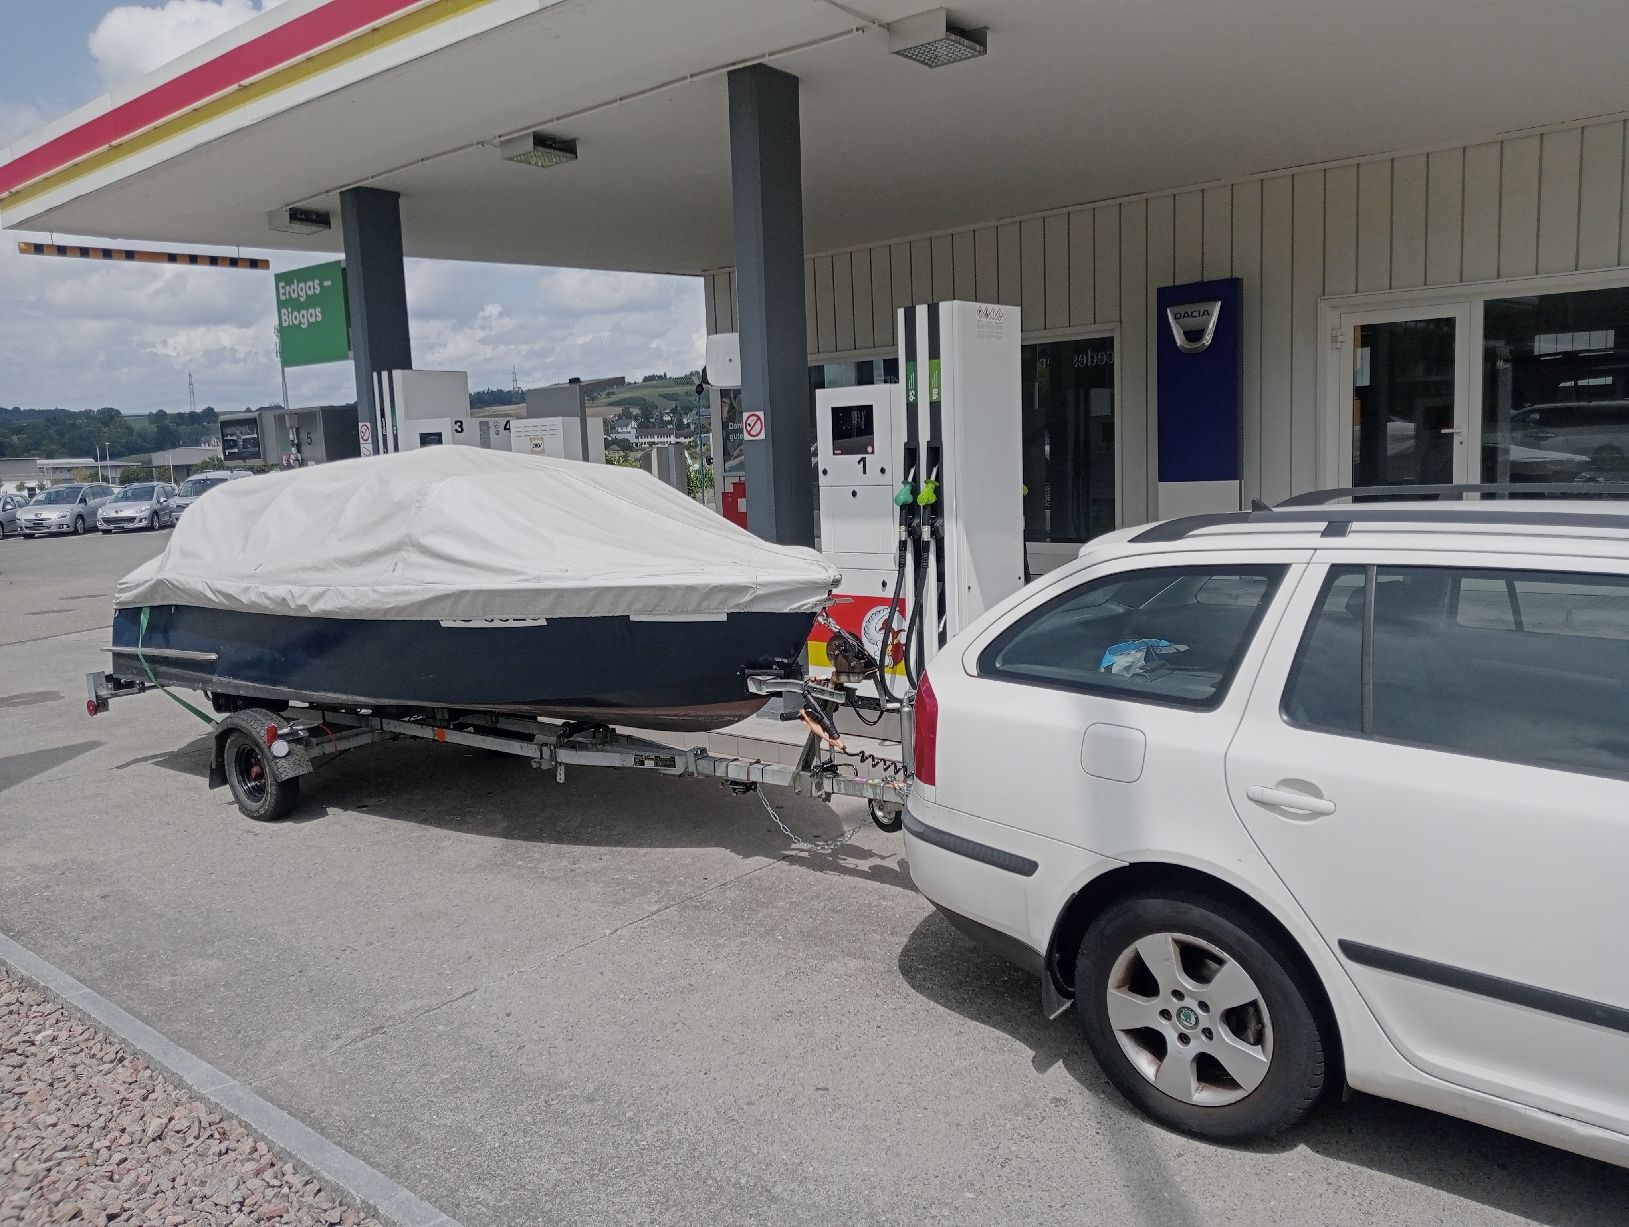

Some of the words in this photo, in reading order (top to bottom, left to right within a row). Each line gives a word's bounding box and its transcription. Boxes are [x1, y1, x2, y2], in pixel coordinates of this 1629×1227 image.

[279, 279, 320, 302] Erdgas
[281, 307, 322, 329] Biogas
[1174, 310, 1210, 320] DACIA
[908, 390, 916, 402] 95
[932, 388, 939, 400] 98
[454, 420, 464, 434] 3
[503, 420, 511, 432] 4
[306, 431, 313, 446] 5
[857, 456, 867, 475] 1
